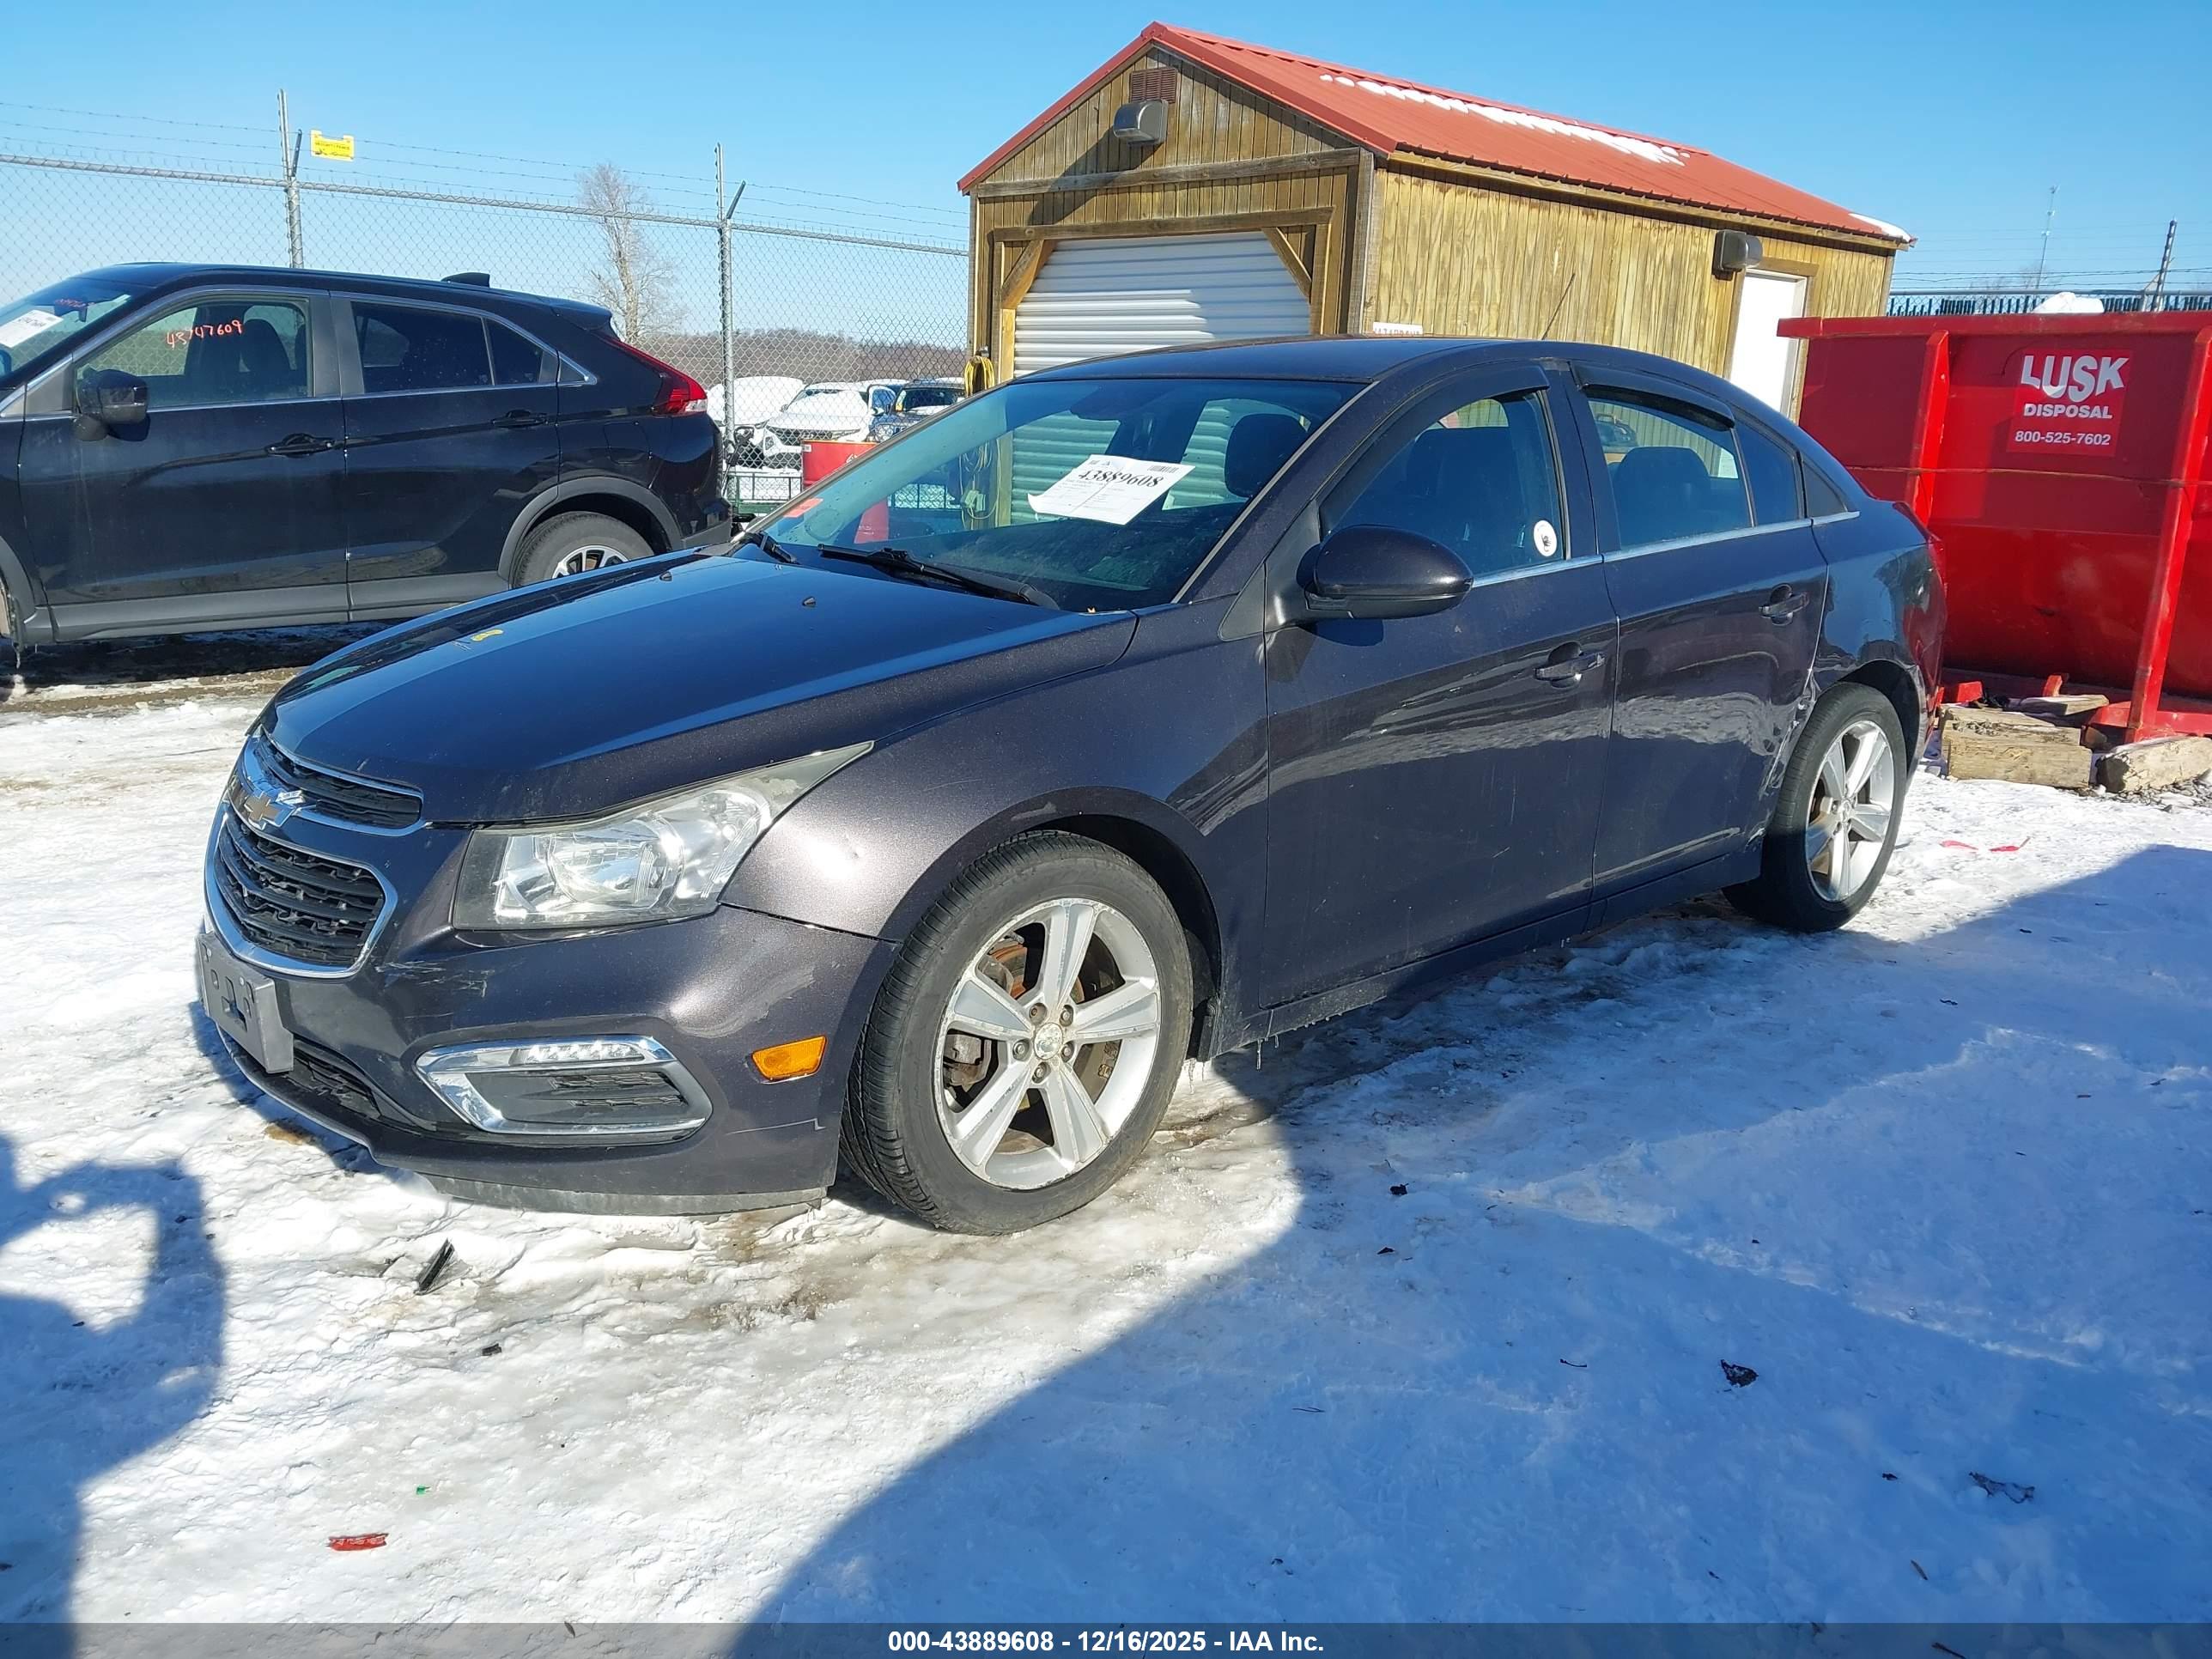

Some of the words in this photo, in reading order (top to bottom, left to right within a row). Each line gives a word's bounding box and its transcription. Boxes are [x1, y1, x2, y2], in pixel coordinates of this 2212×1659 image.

[2021, 355, 2130, 403] LUSK
[2023, 403, 2113, 420] DISPOSAL
[2014, 430, 2112, 446] 800-525-7602
[1078, 469, 1164, 488] 43889608
